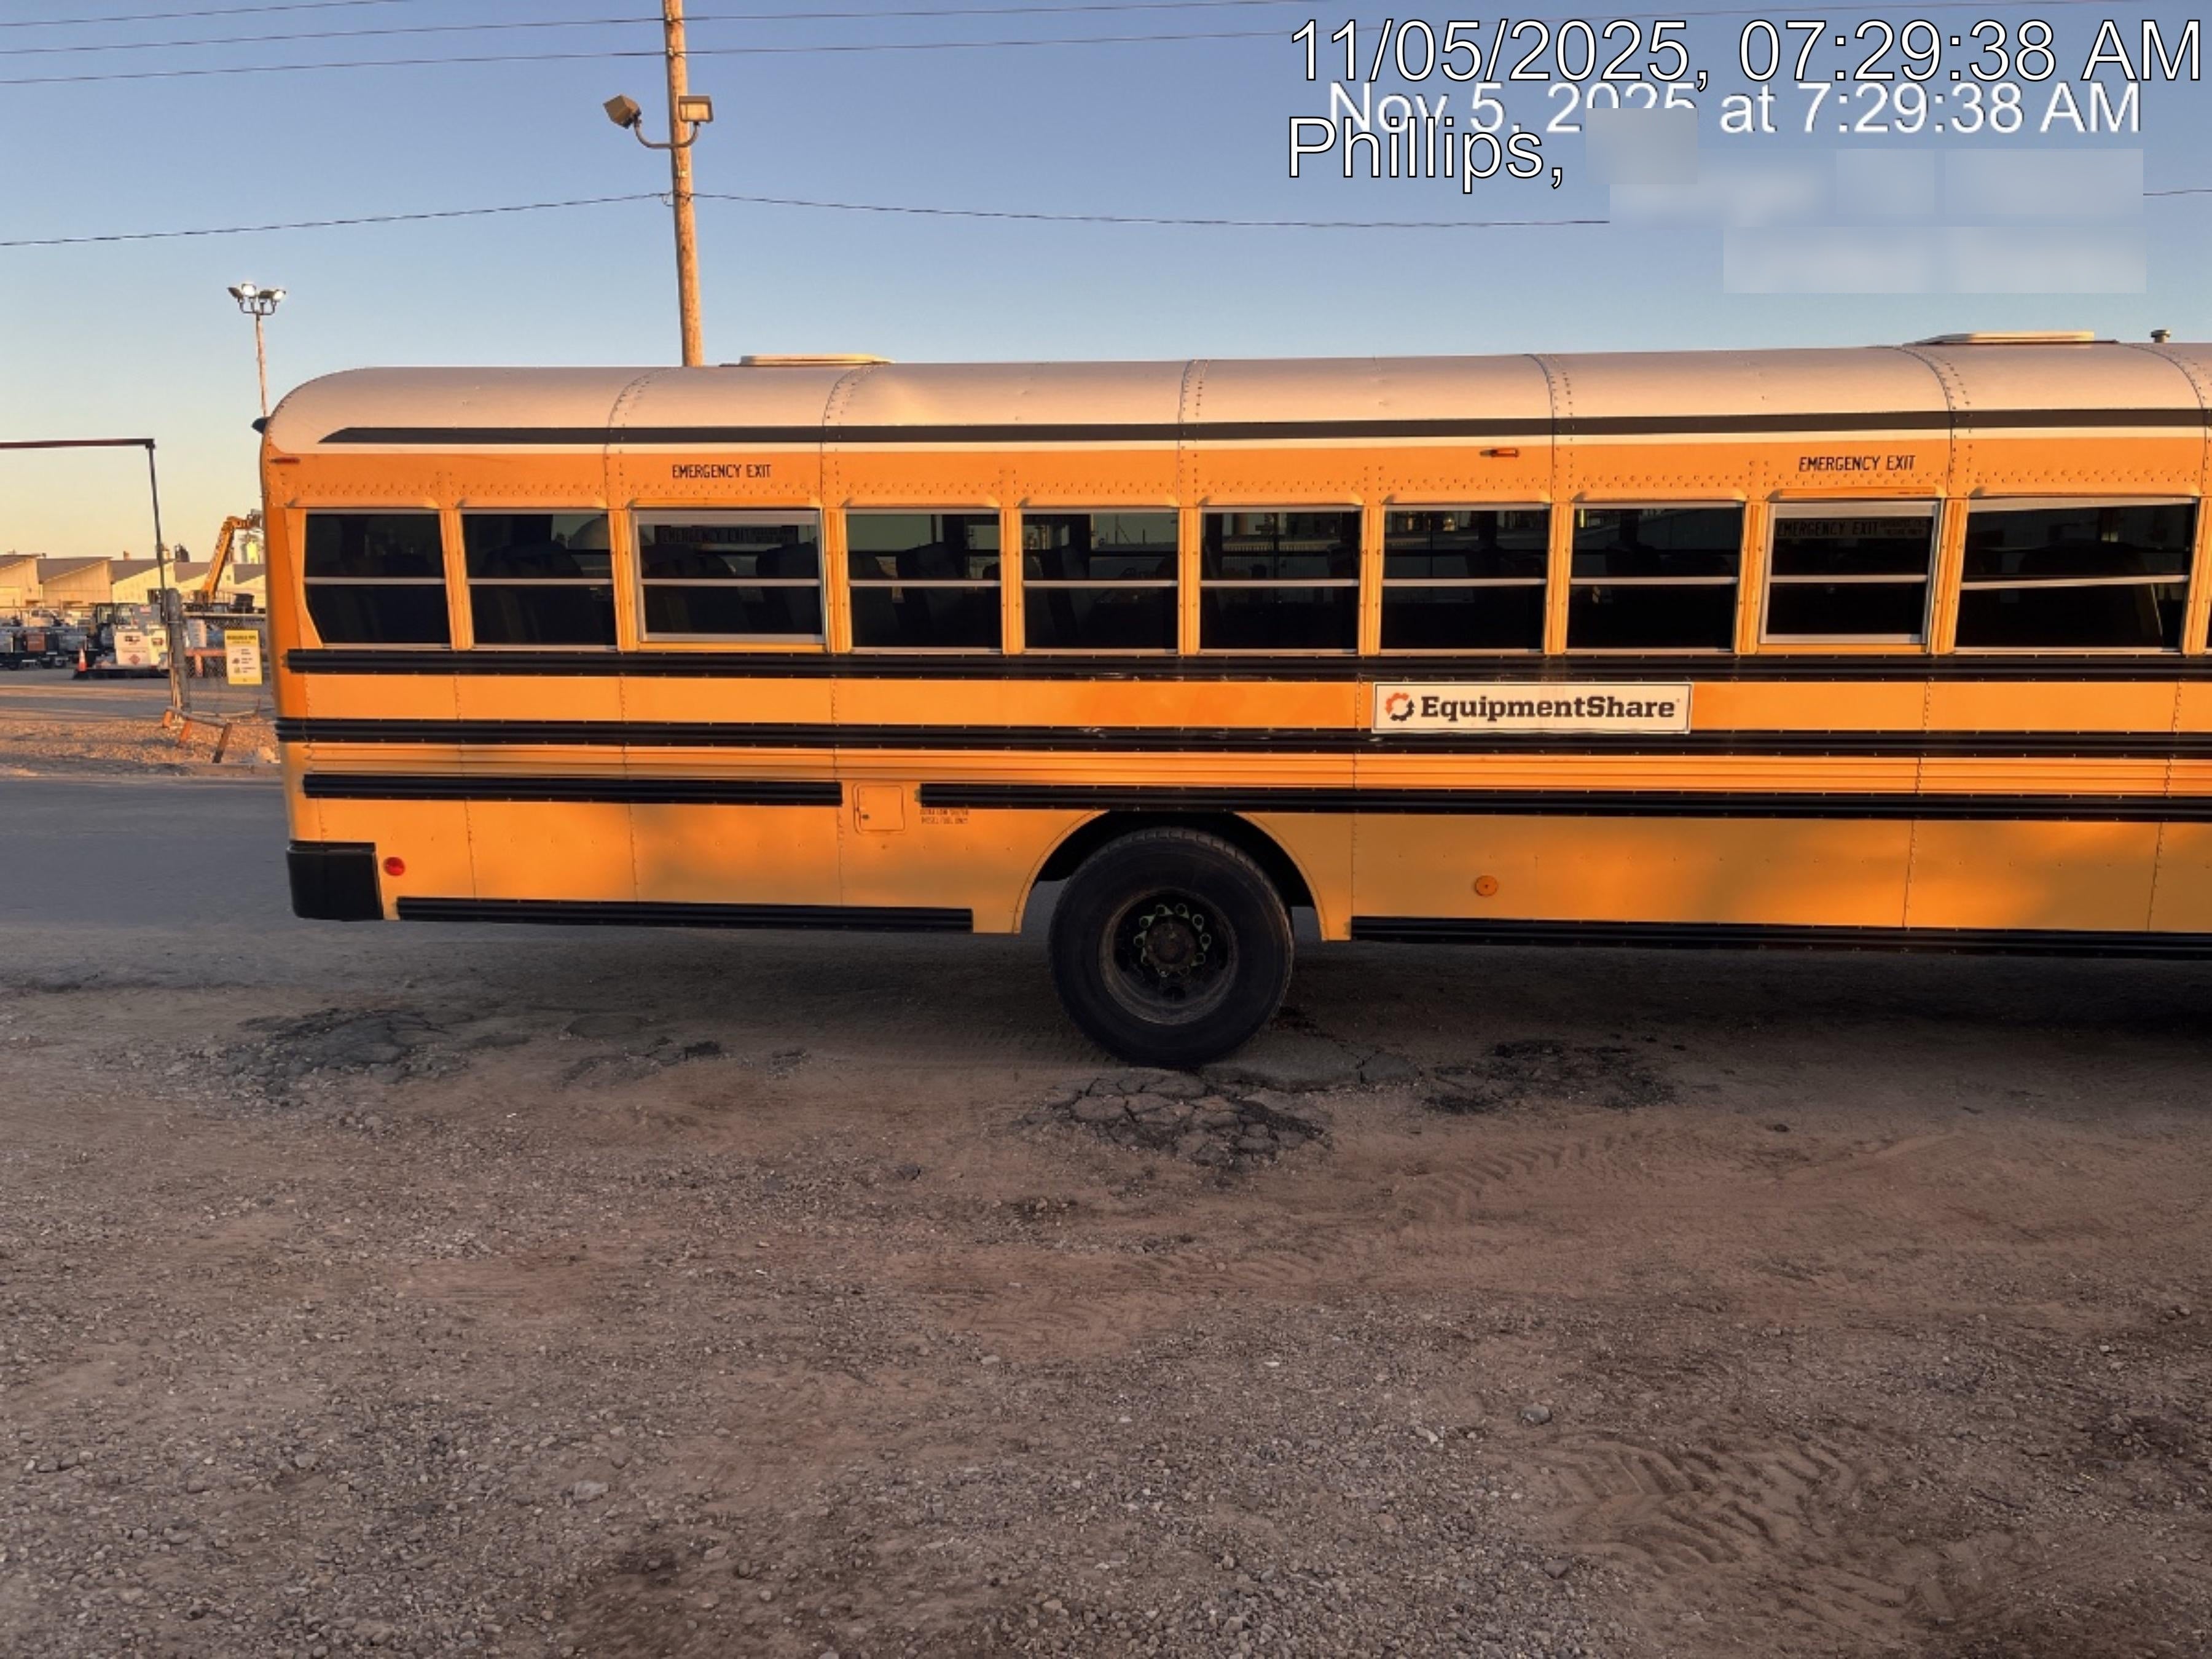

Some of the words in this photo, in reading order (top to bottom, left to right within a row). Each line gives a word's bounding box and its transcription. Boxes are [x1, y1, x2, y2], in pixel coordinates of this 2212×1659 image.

[672, 465, 742, 478] EMERGENCY
[746, 465, 771, 478] EXIT
[1798, 456, 1881, 472] EMERGENCY
[1886, 455, 1916, 471] EXIT
[1421, 696, 1676, 723] EquipmentShare
